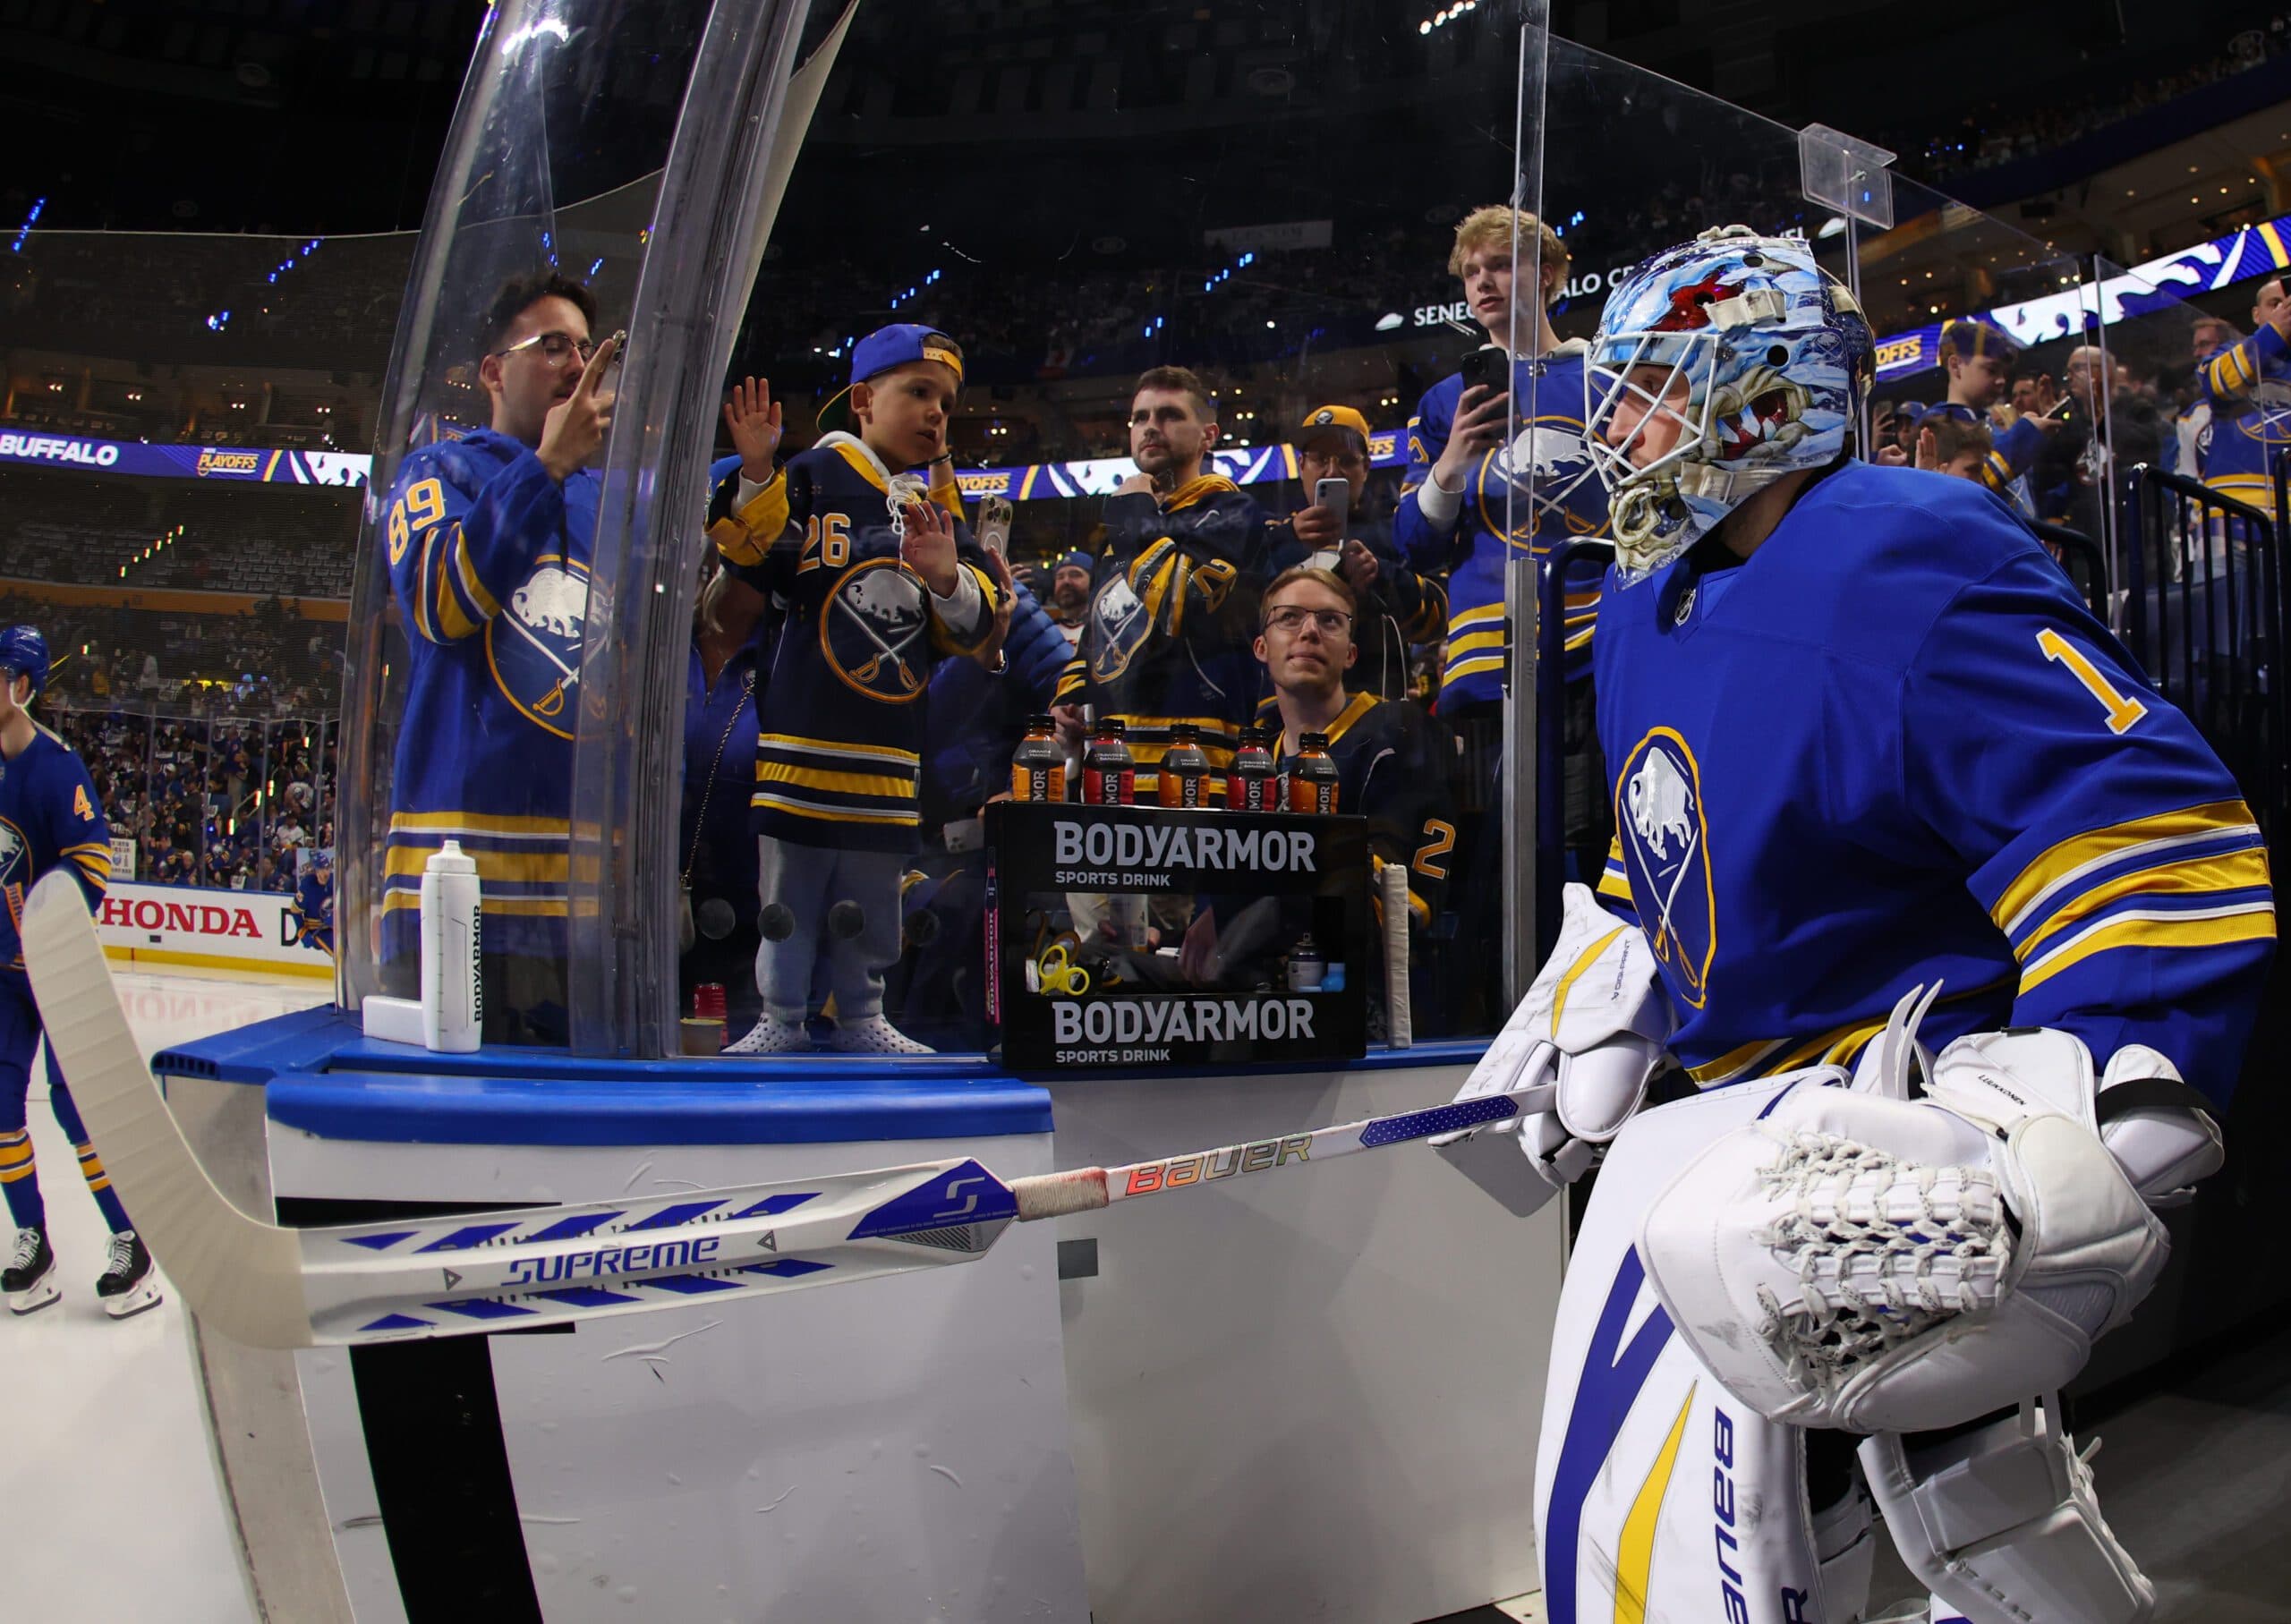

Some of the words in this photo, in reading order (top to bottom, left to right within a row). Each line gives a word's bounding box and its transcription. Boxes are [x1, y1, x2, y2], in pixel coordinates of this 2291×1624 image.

[1876, 338, 1922, 365] OFFS
[0, 434, 118, 466] BUFFALO
[198, 453, 259, 471] PLAYOFFS
[388, 477, 446, 565] 89
[797, 513, 851, 575] 26
[2035, 627, 2148, 735] 1
[73, 784, 95, 821] 4
[1054, 821, 1316, 872] BODYARMOR
[1055, 872, 1118, 885] SPORTS
[1123, 873, 1171, 886] DRINK
[100, 897, 262, 938] HONDA
[473, 905, 482, 1023] BODYARMOR
[1052, 999, 1316, 1044] BODYARMOR
[1055, 1050, 1118, 1063] SPORTS
[1123, 1049, 1171, 1062] DRINK
[1125, 1132, 1313, 1196] BAUER
[499, 1237, 720, 1286] SUPREME
